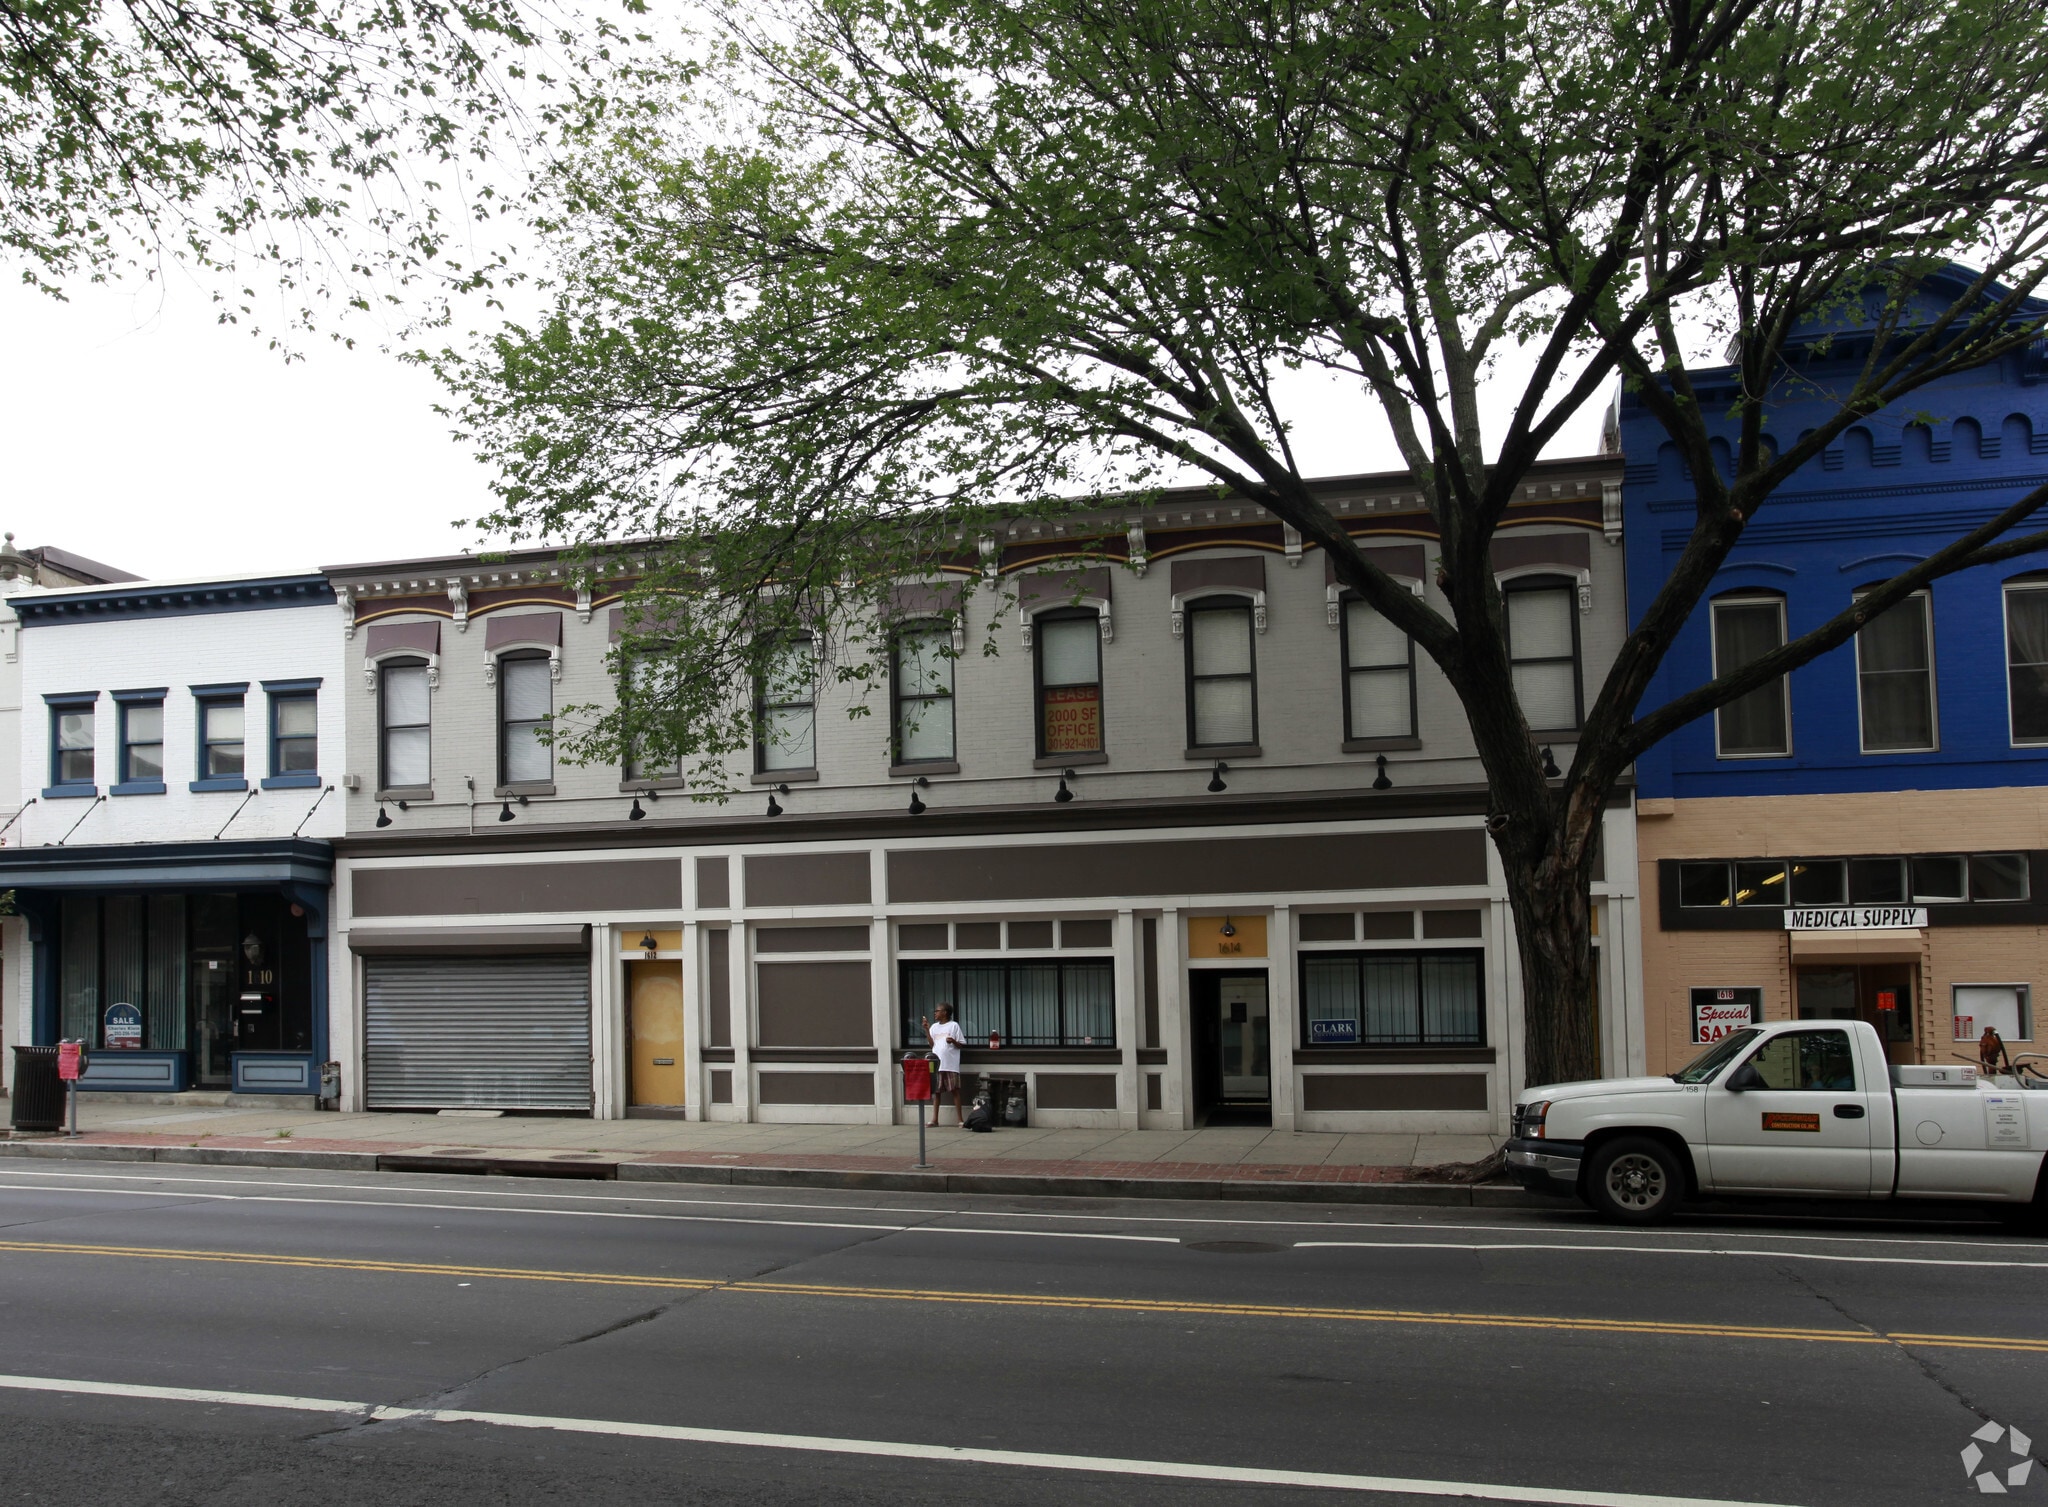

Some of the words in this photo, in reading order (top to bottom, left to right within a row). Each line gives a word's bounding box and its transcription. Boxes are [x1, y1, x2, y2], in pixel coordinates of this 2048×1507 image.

[1047, 687, 1095, 700] LEASE
[1048, 709, 1077, 722] 2000
[1081, 707, 1097, 721] SF
[1047, 723, 1096, 737] OFFICE
[1048, 737, 1099, 750] 301-921-4101
[1792, 910, 1858, 928] MEDICAL
[1863, 908, 1917, 926] SUPPLY
[1219, 942, 1241, 954] 1614
[644, 951, 657, 960] 1612
[1718, 990, 1734, 999] 1618
[1699, 1005, 1750, 1023] Special
[112, 1017, 135, 1025] SALE
[1313, 1023, 1354, 1033] CLARK
[1699, 1025, 1747, 1043] SA
[1685, 1085, 1699, 1093] 158
